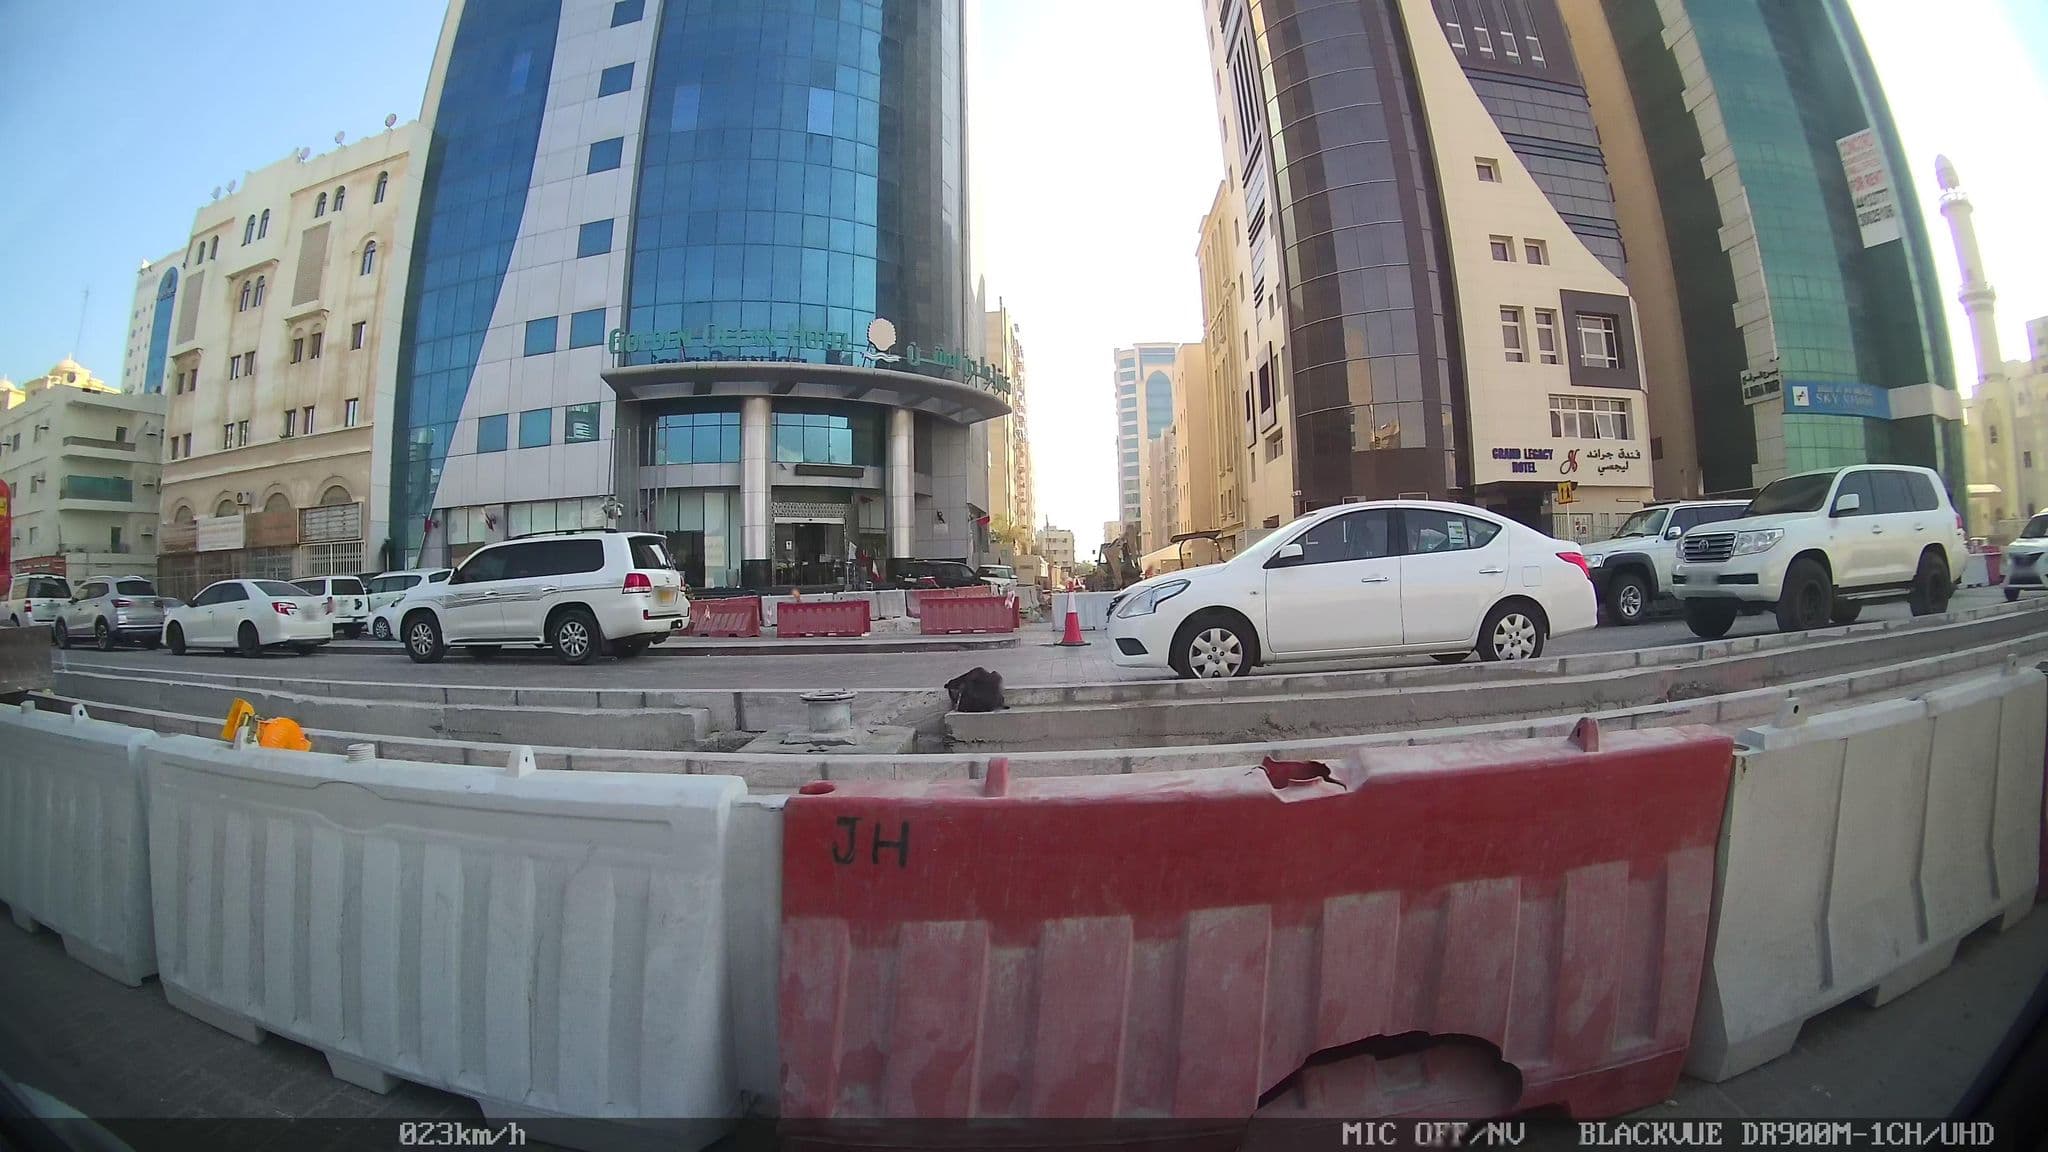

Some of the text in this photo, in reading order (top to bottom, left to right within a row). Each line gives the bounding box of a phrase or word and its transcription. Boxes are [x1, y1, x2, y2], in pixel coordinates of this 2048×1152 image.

[1492, 448, 1553, 460] GRAND LEGACY
[1587, 449, 1613, 460] جراند
[1512, 462, 1537, 473] HOTEL
